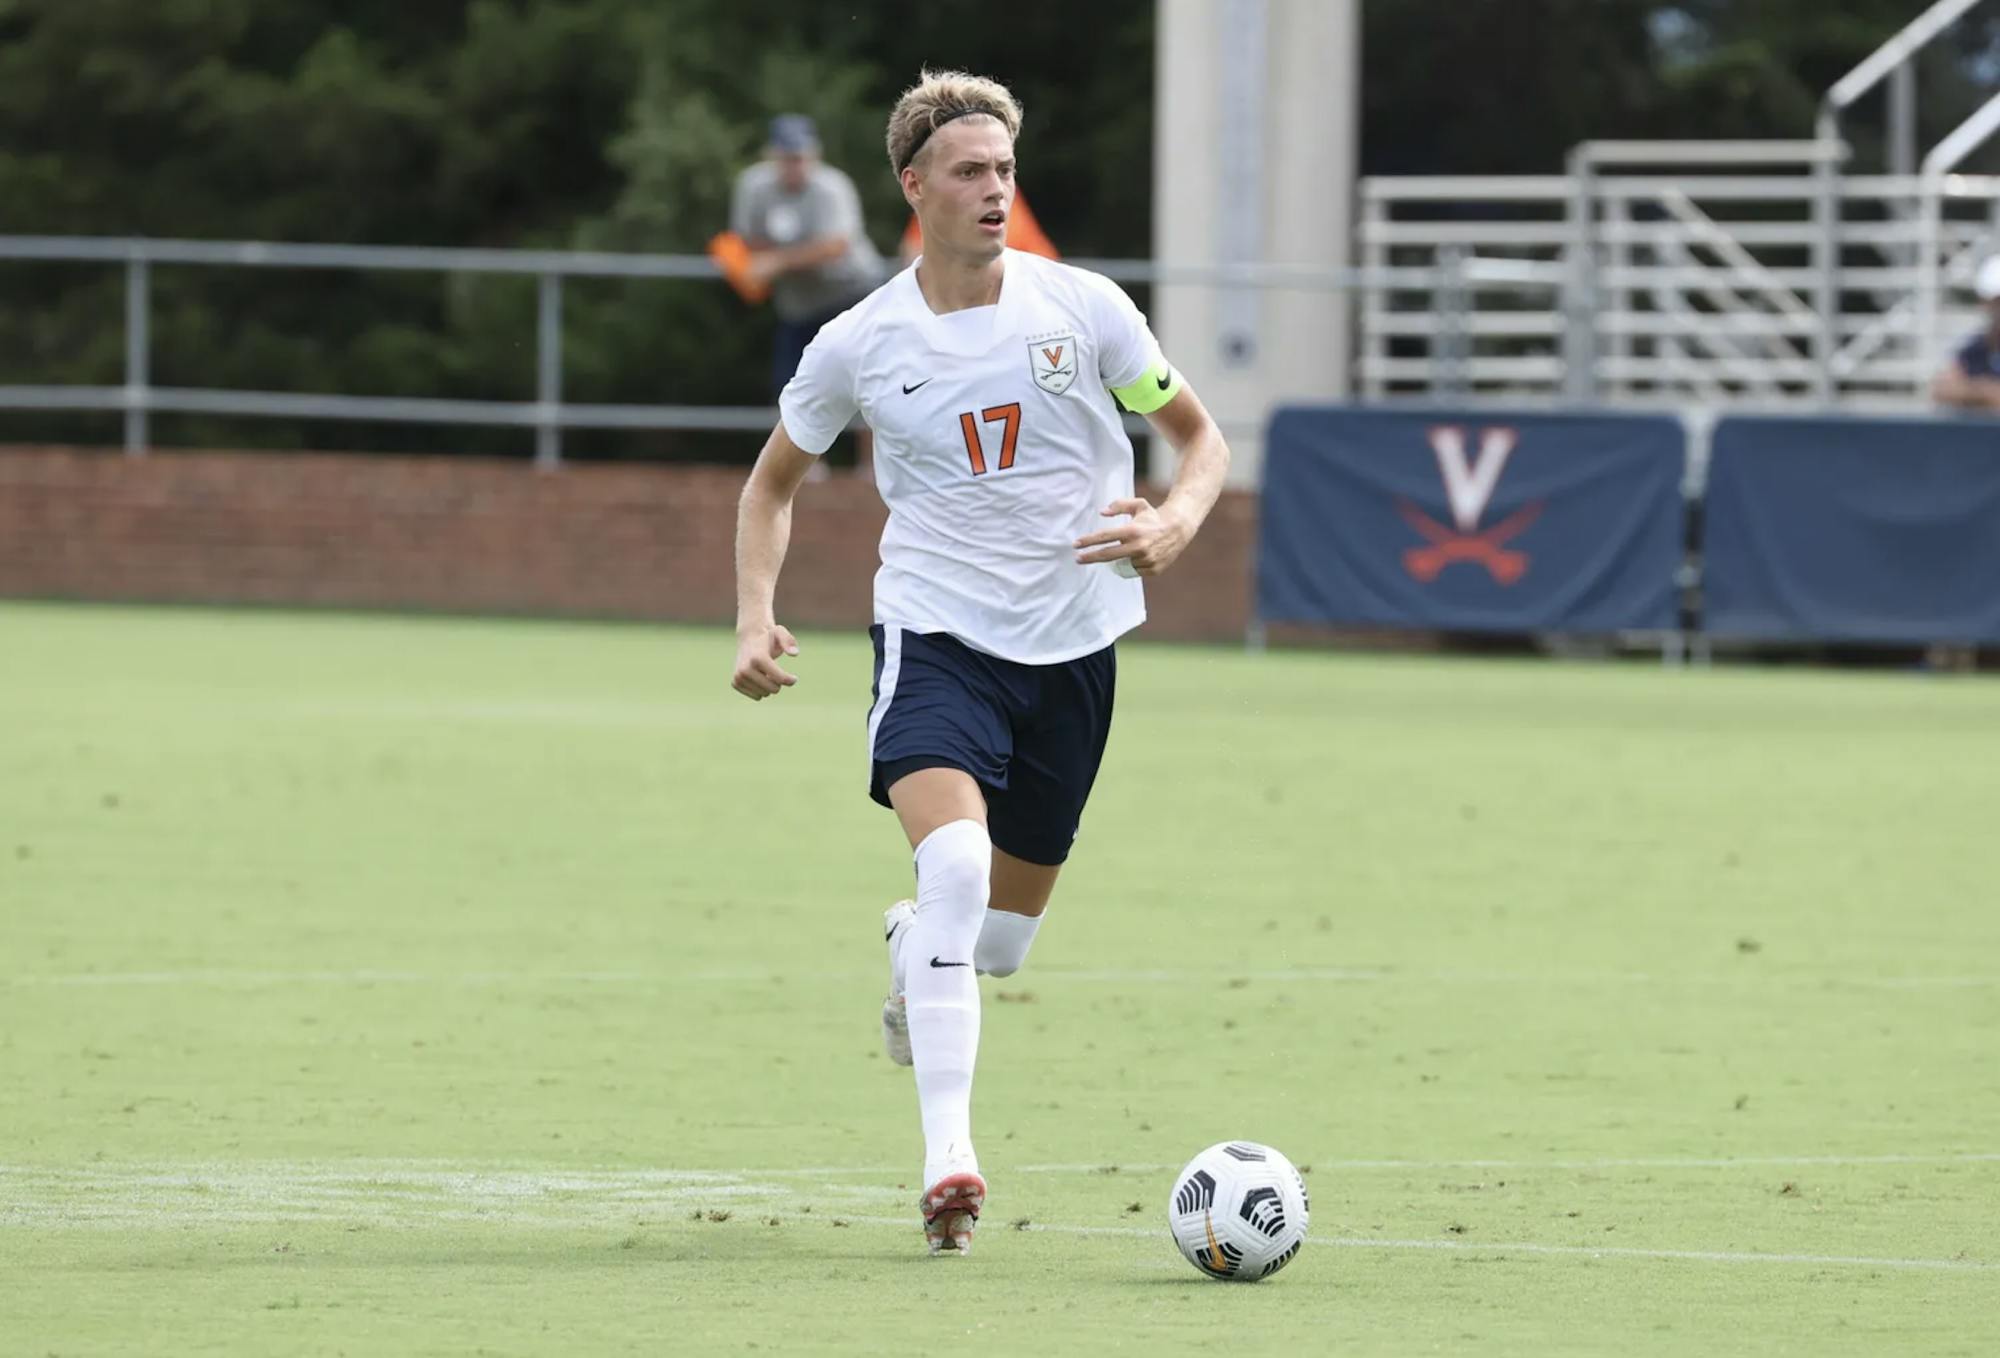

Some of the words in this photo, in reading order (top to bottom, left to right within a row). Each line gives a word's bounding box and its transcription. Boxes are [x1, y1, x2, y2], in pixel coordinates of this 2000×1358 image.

[1042, 345, 1063, 368] V
[959, 402, 1022, 476] 17
[1428, 426, 1516, 532] V
